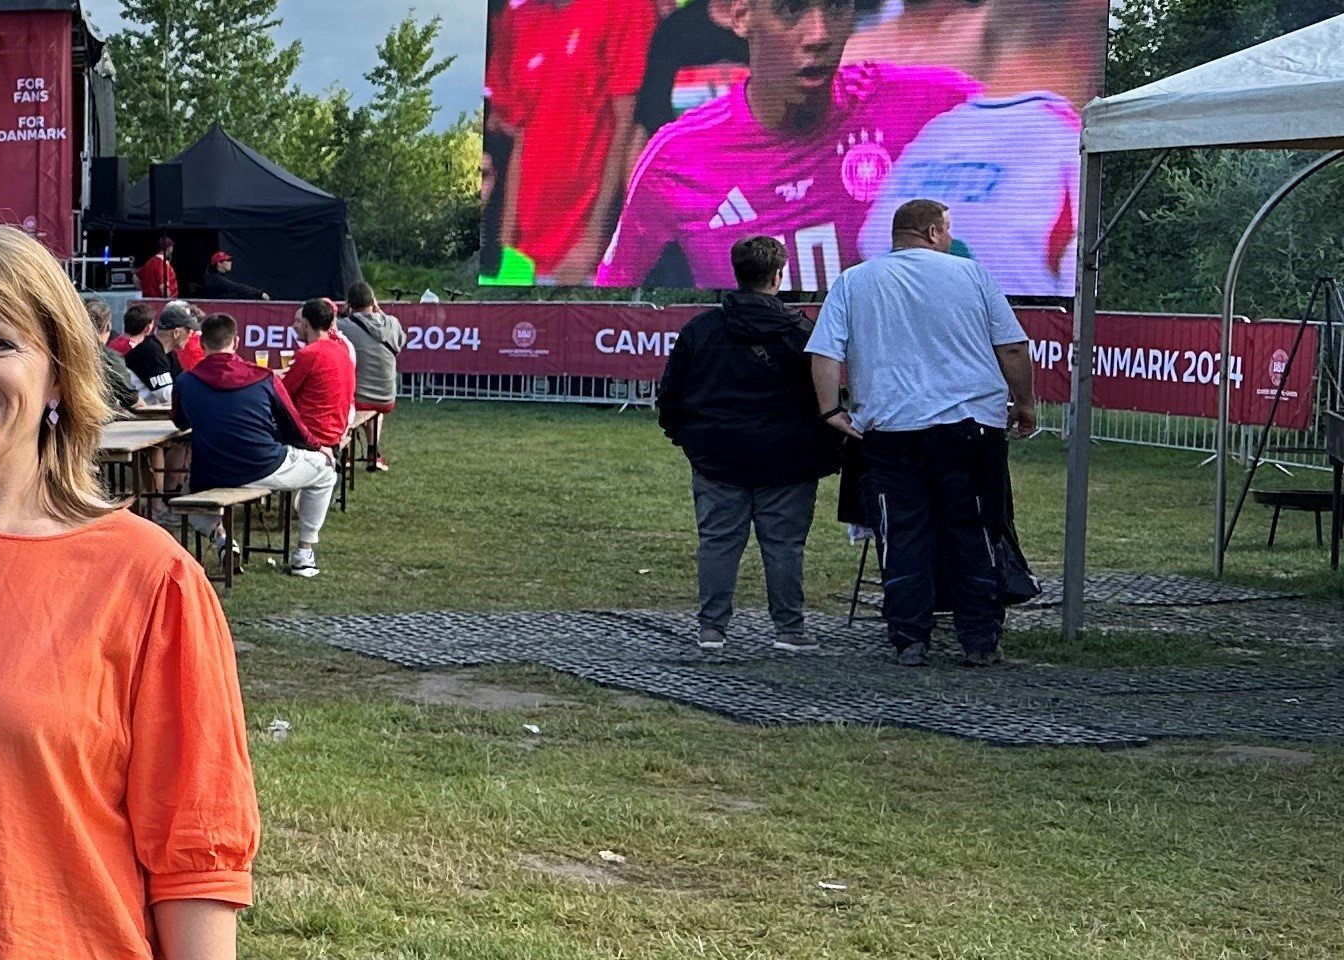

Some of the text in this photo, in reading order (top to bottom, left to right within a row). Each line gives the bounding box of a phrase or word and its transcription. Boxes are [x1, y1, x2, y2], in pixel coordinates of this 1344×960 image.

[17, 78, 44, 90] FOR
[13, 90, 49, 103] FANS
[18, 116, 44, 128] FOR
[406, 326, 481, 351] 2024
[595, 328, 680, 356] CAMP
[1067, 342, 1178, 383] NMARK
